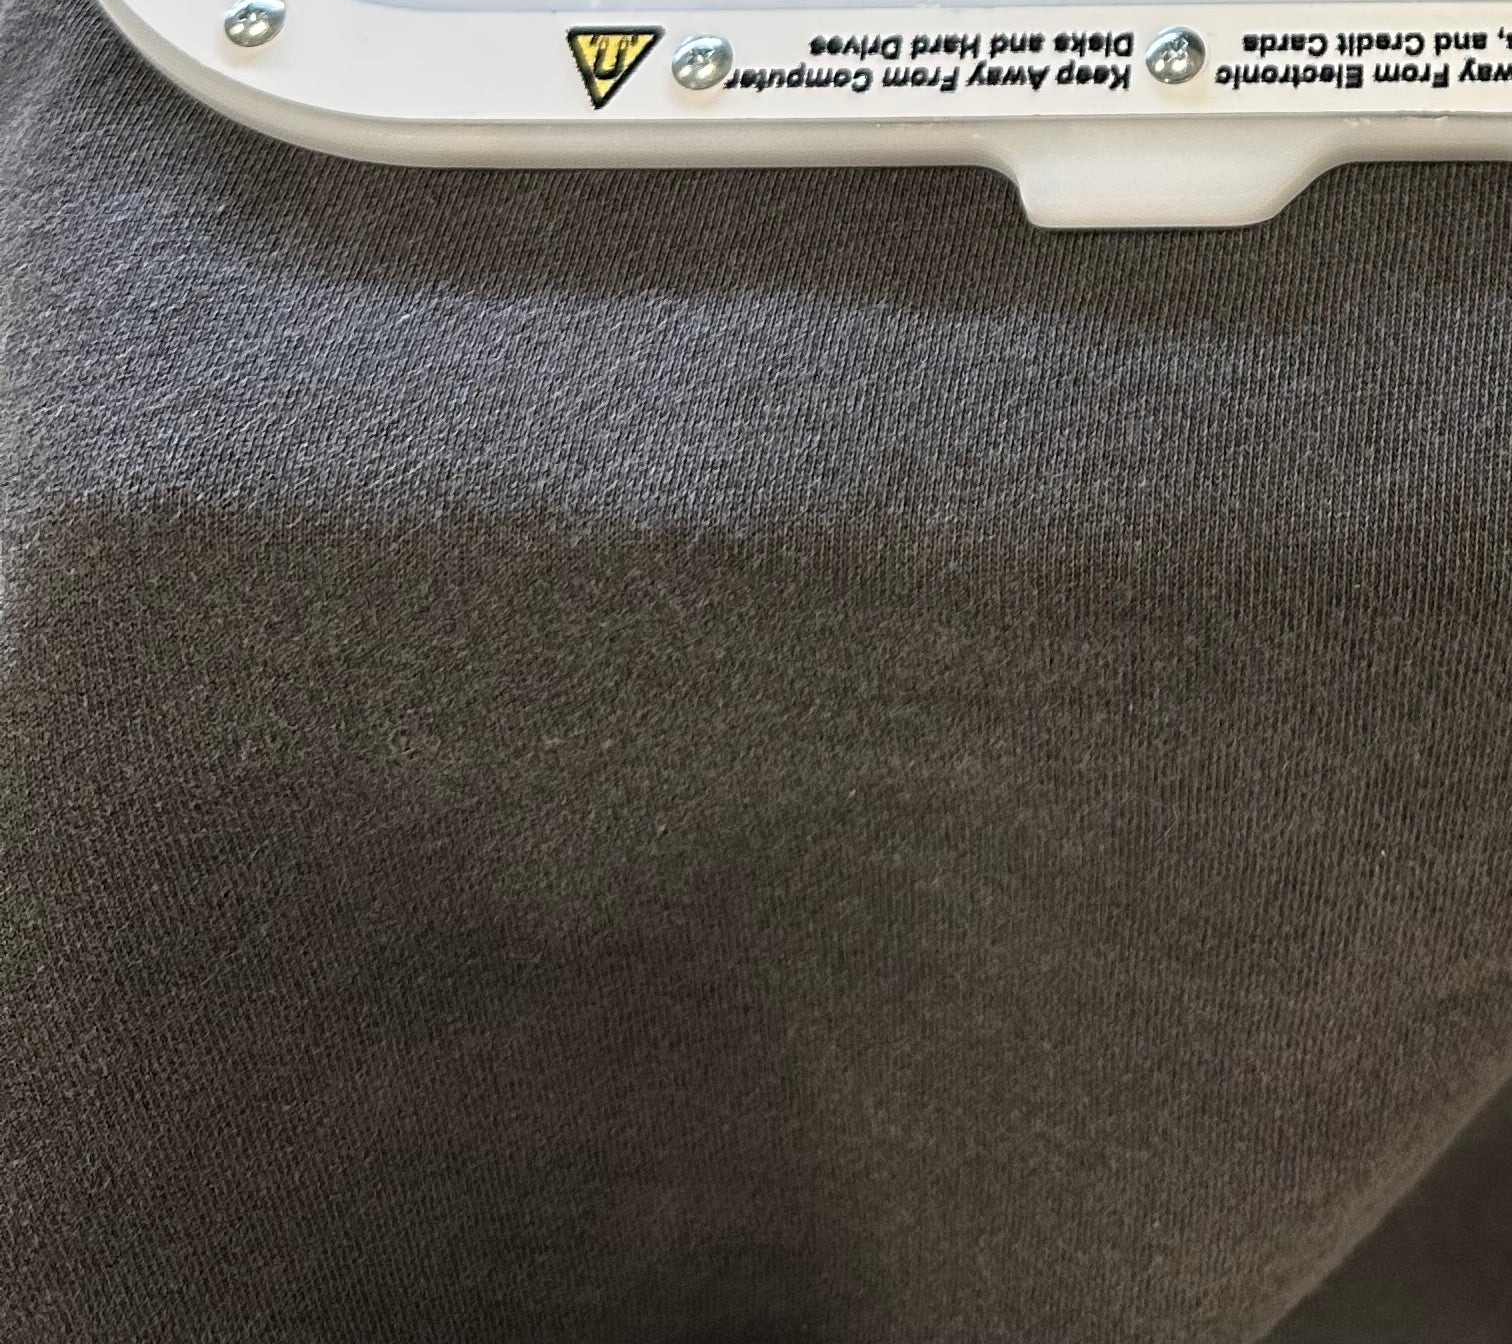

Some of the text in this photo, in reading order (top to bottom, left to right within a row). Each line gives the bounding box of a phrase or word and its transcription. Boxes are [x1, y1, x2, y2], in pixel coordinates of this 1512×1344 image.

[808, 31, 1135, 61] Disks and Hard Drives
[1243, 32, 1328, 57] Cards
[1336, 31, 1426, 56] Credit
[1434, 31, 1488, 55] and
[722, 59, 1132, 93] Keep Away From Computer
[1214, 62, 1364, 90] Electronic
[1373, 62, 1450, 88] From
